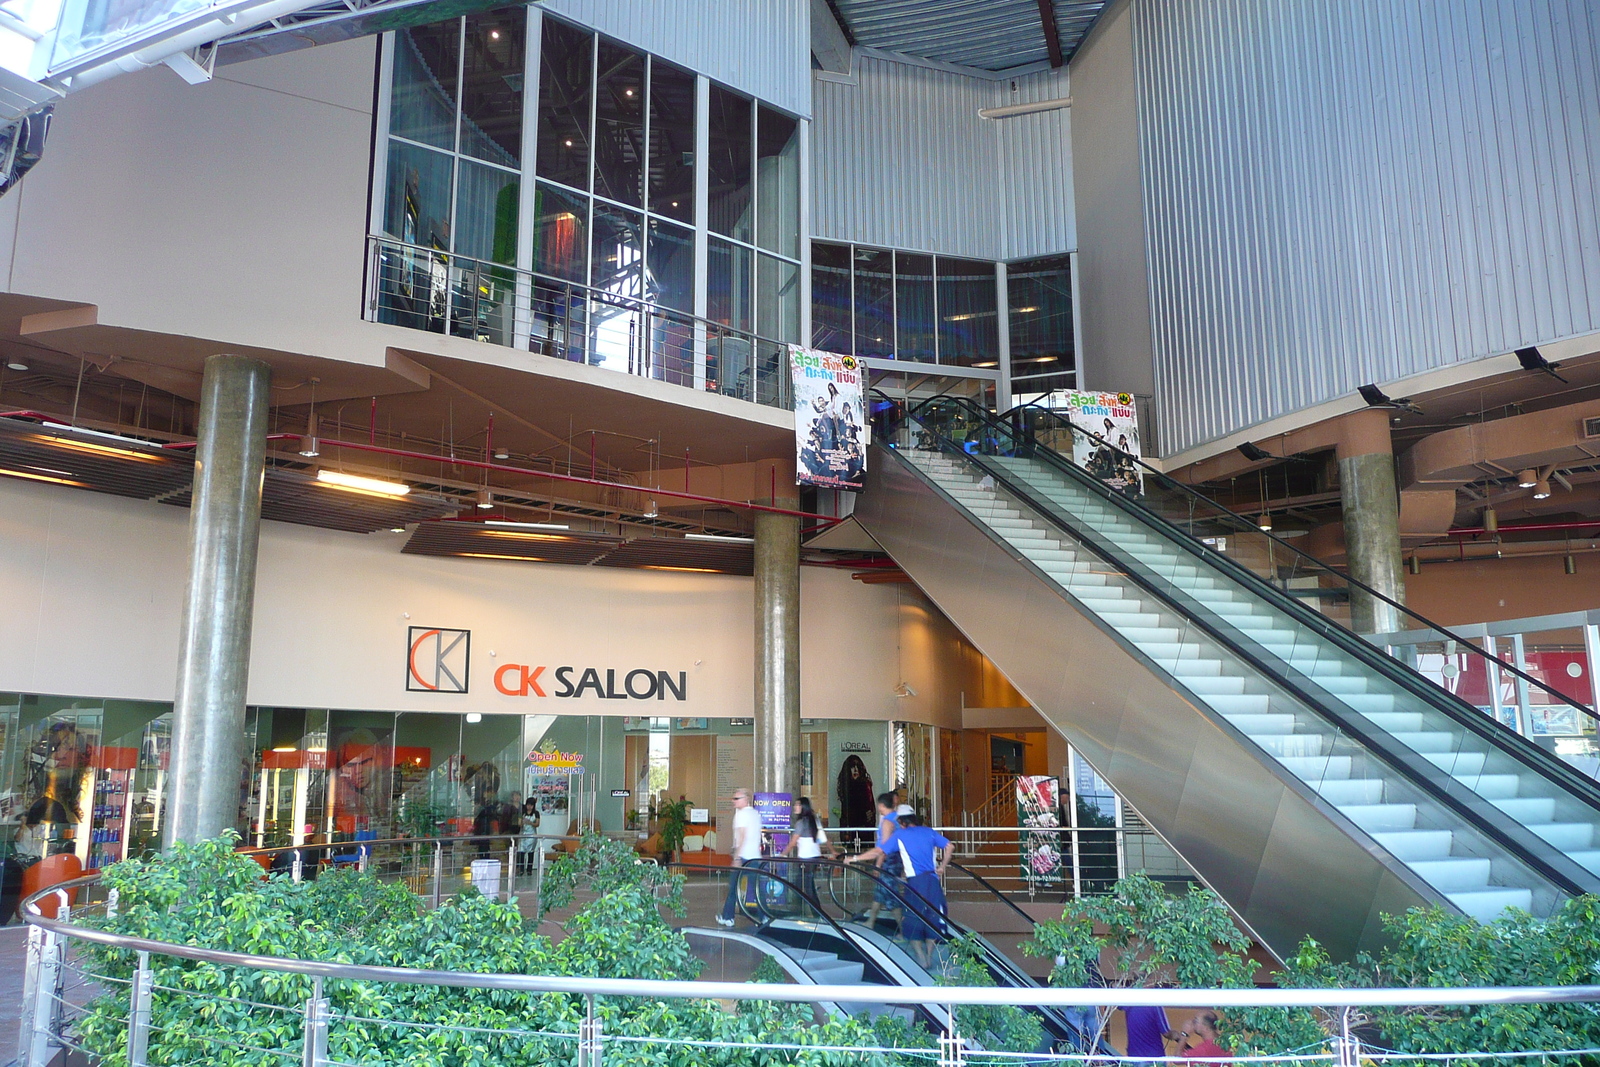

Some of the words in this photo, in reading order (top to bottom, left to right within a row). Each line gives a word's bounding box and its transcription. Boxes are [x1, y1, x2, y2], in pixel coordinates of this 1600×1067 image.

[794, 350, 820, 368] สวย
[822, 356, 843, 371] สิงห์
[805, 366, 834, 381] กระทิง
[1070, 393, 1096, 408] สวย
[1098, 393, 1118, 407] สิงห์
[1082, 405, 1109, 416] กระทิง
[409, 629, 466, 691] CK
[493, 663, 547, 698] CK
[554, 666, 687, 701] SALON
[528, 751, 558, 762] Open
[560, 752, 583, 762] Now
